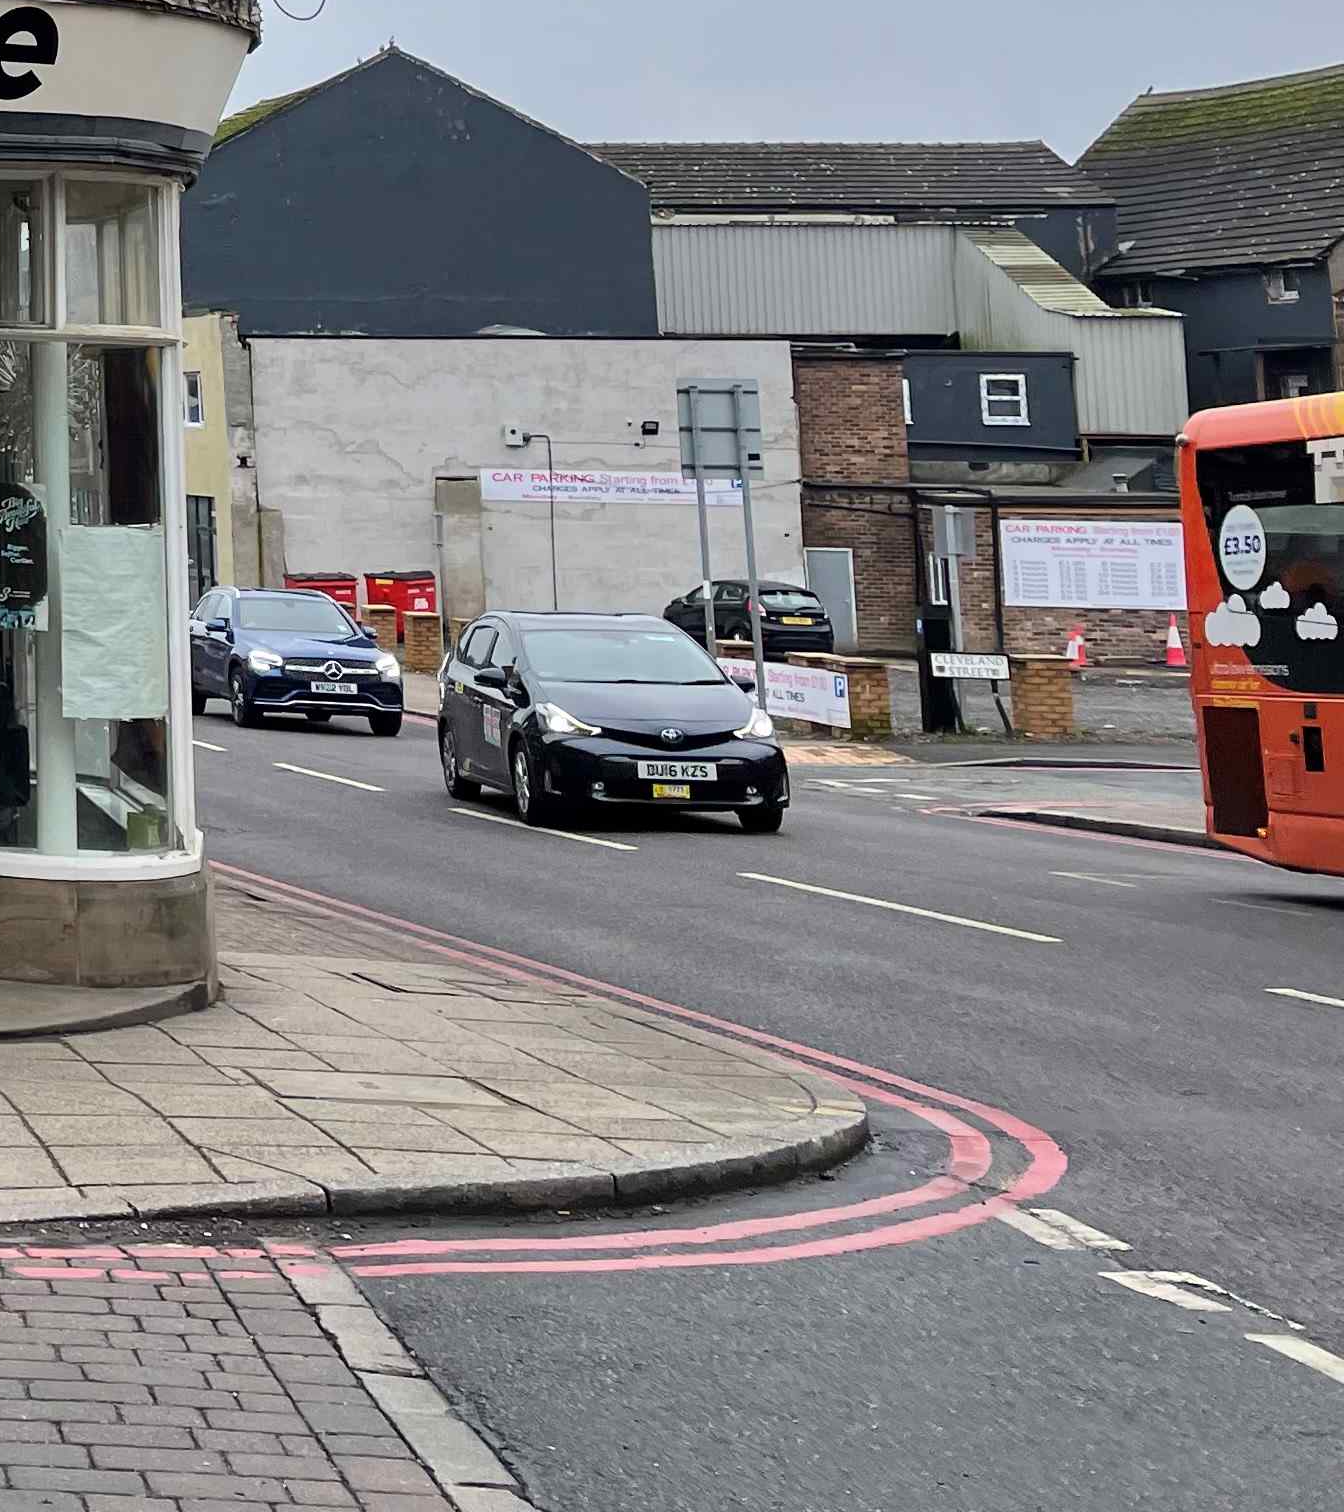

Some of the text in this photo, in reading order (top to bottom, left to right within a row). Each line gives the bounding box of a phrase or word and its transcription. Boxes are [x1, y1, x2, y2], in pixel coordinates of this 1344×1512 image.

[492, 472, 524, 483] CAR
[530, 473, 595, 485] PARKING
[599, 473, 648, 487] Starting
[650, 475, 679, 486] from
[532, 484, 578, 493] CHARGES
[582, 486, 610, 494] APPLY
[615, 486, 629, 494] AT
[1005, 524, 1031, 534] CAR
[1036, 524, 1088, 535] PARKING
[1011, 537, 1061, 545] CHARGES
[1065, 538, 1097, 546] APPLY
[1103, 538, 1114, 546] AT
[1223, 535, 1261, 556] £3.50
[935, 654, 1004, 666] CLEVELAND
[948, 666, 991, 677] STREET
[772, 687, 806, 703] ALL TIMES
[681, 763, 709, 778] KZS
